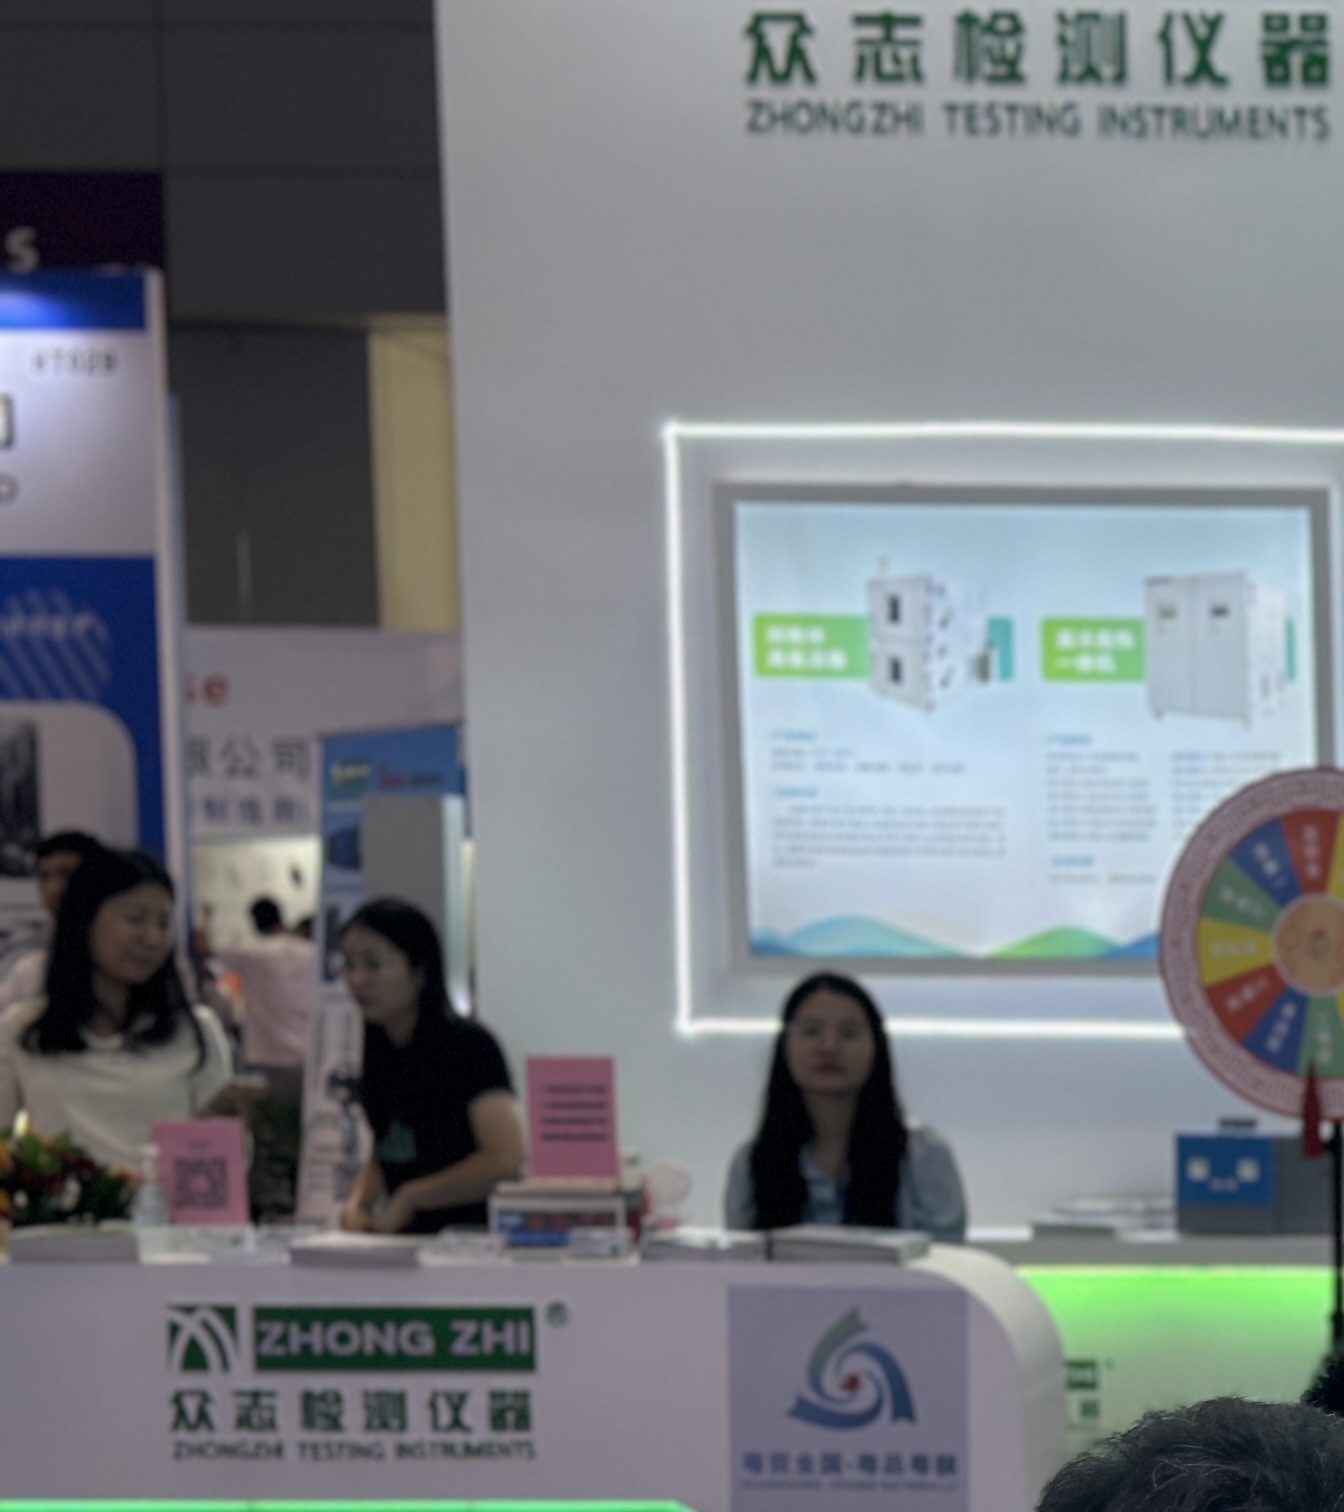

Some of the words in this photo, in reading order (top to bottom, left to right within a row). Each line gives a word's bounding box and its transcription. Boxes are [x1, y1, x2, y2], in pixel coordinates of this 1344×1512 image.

[745, 12, 1332, 87] 众志检测仪器
[746, 100, 925, 136] ZHONGZHI
[945, 102, 1082, 138] TESTING
[1099, 104, 1332, 142] INSTRUMENTS
[257, 1320, 436, 1357] ZHONG
[450, 1320, 531, 1357] ZHI
[170, 1388, 532, 1433] 众志检测仪器
[297, 1440, 385, 1462] TESTING
